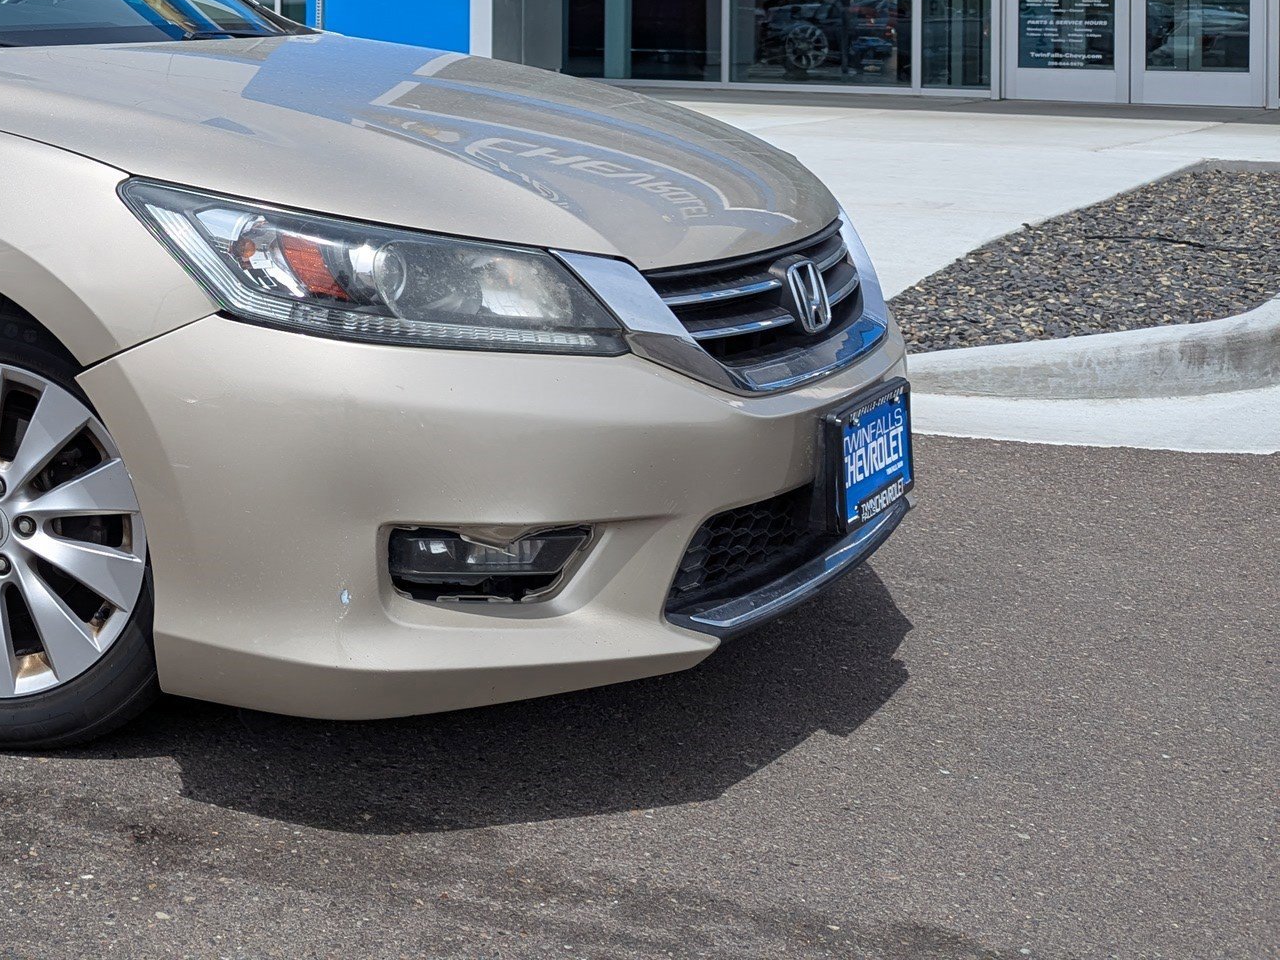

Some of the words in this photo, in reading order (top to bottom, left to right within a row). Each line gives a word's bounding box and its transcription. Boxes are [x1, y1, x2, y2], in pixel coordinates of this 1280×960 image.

[844, 408, 903, 456] TWINFALLS
[845, 426, 903, 489] HEVROLET
[873, 477, 904, 513] CHEVROLET
